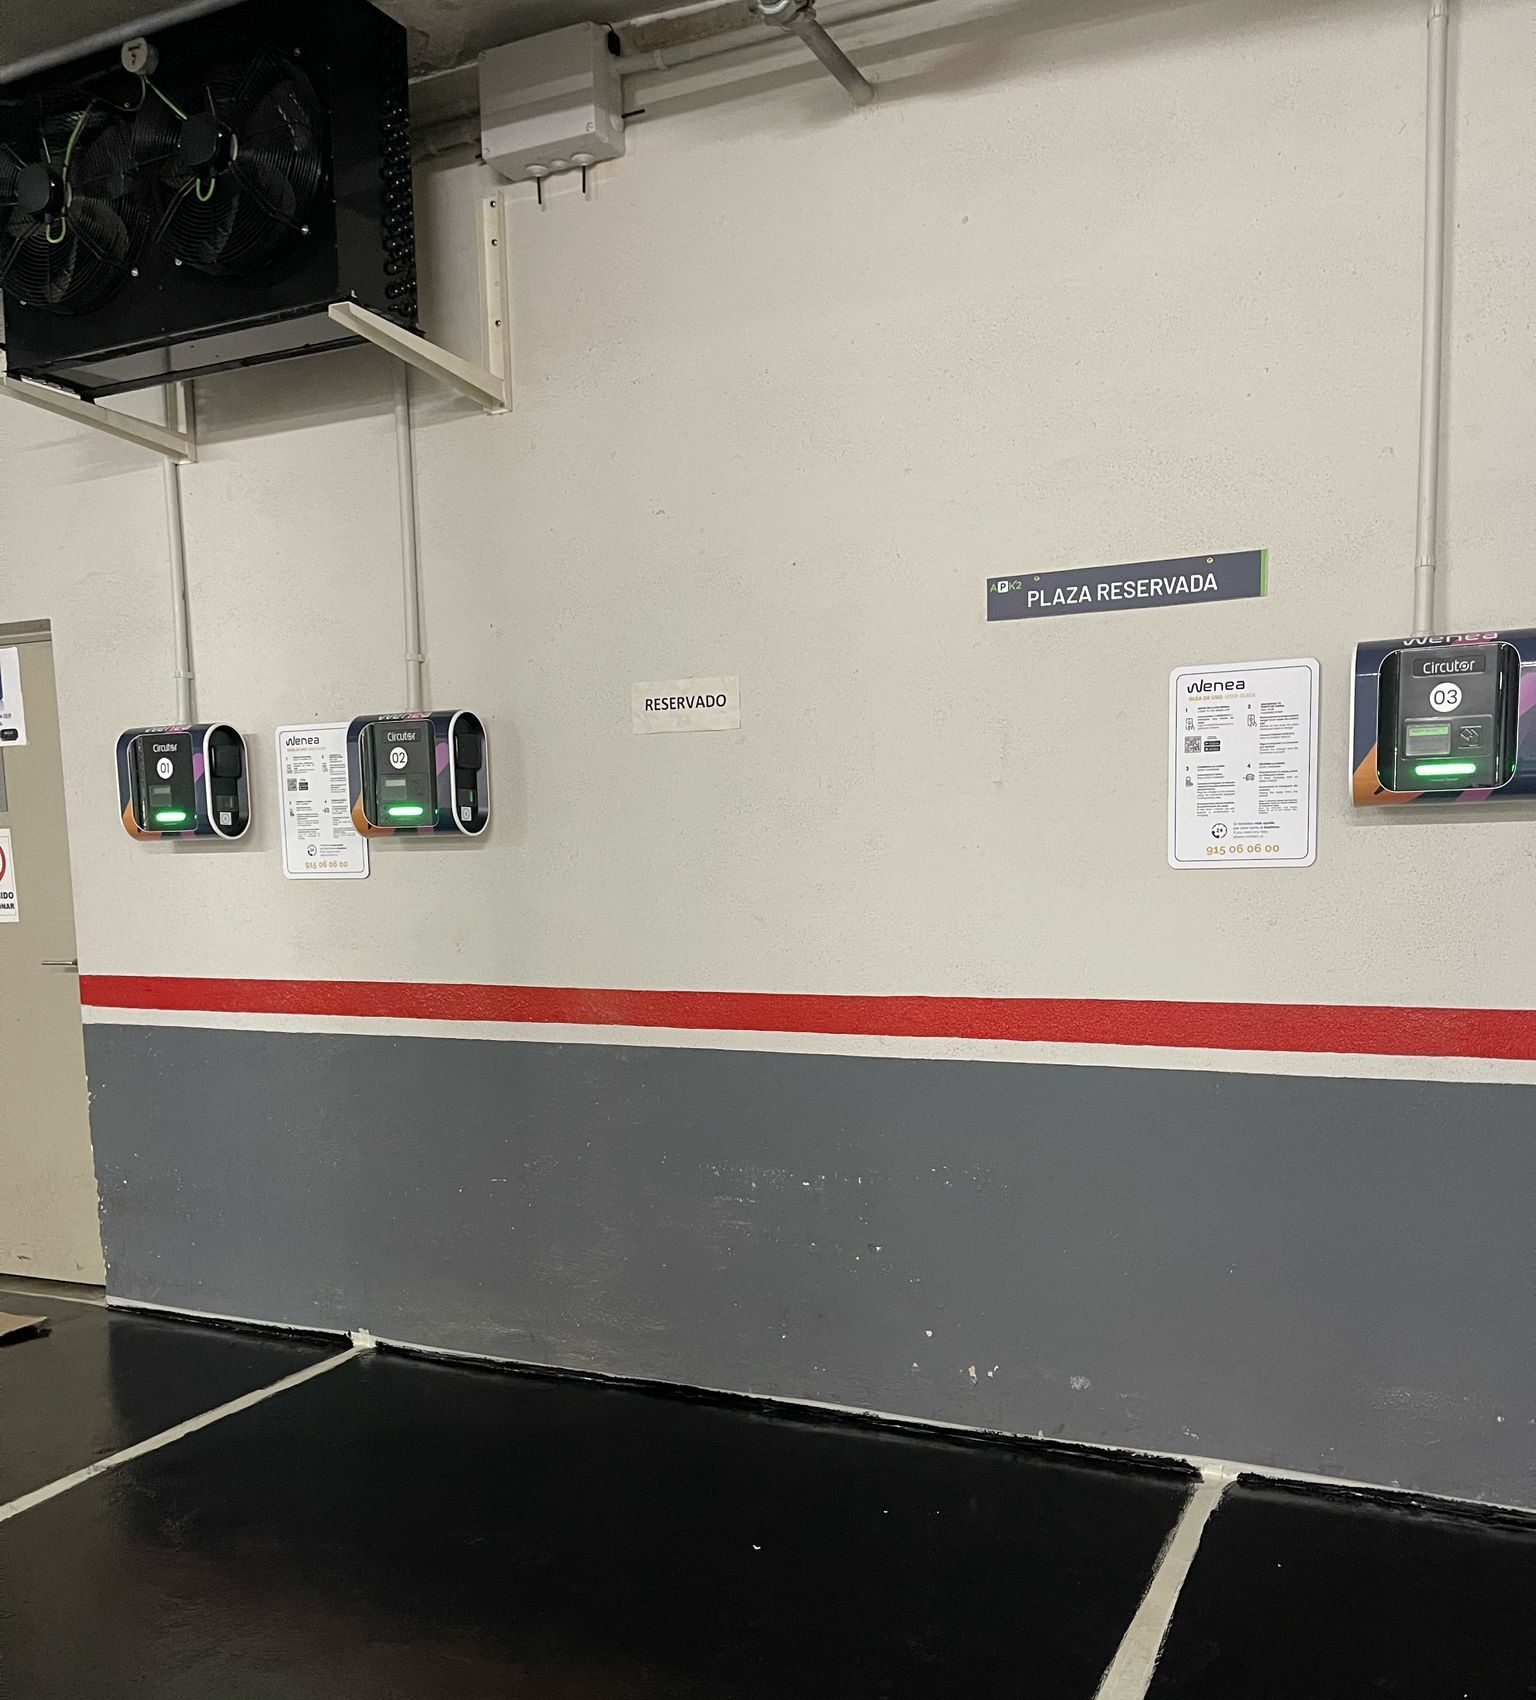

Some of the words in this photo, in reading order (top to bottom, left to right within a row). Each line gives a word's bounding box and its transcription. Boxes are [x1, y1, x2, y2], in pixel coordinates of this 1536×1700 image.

[1027, 585, 1092, 608] PLAZA
[1097, 572, 1218, 601] RESERVADA
[1423, 660, 1476, 674] Circutor
[1187, 679, 1245, 693] Wenea
[645, 694, 727, 711] RESERVADO
[1434, 689, 1458, 705] 03
[285, 736, 320, 746] Wenea
[387, 731, 416, 742] Circutor
[392, 752, 406, 764] 02
[160, 763, 170, 774] 01
[1206, 845, 1226, 855] 915
[1229, 844, 1243, 853] 06
[1247, 843, 1261, 853] 06
[1265, 844, 1280, 852] 00
